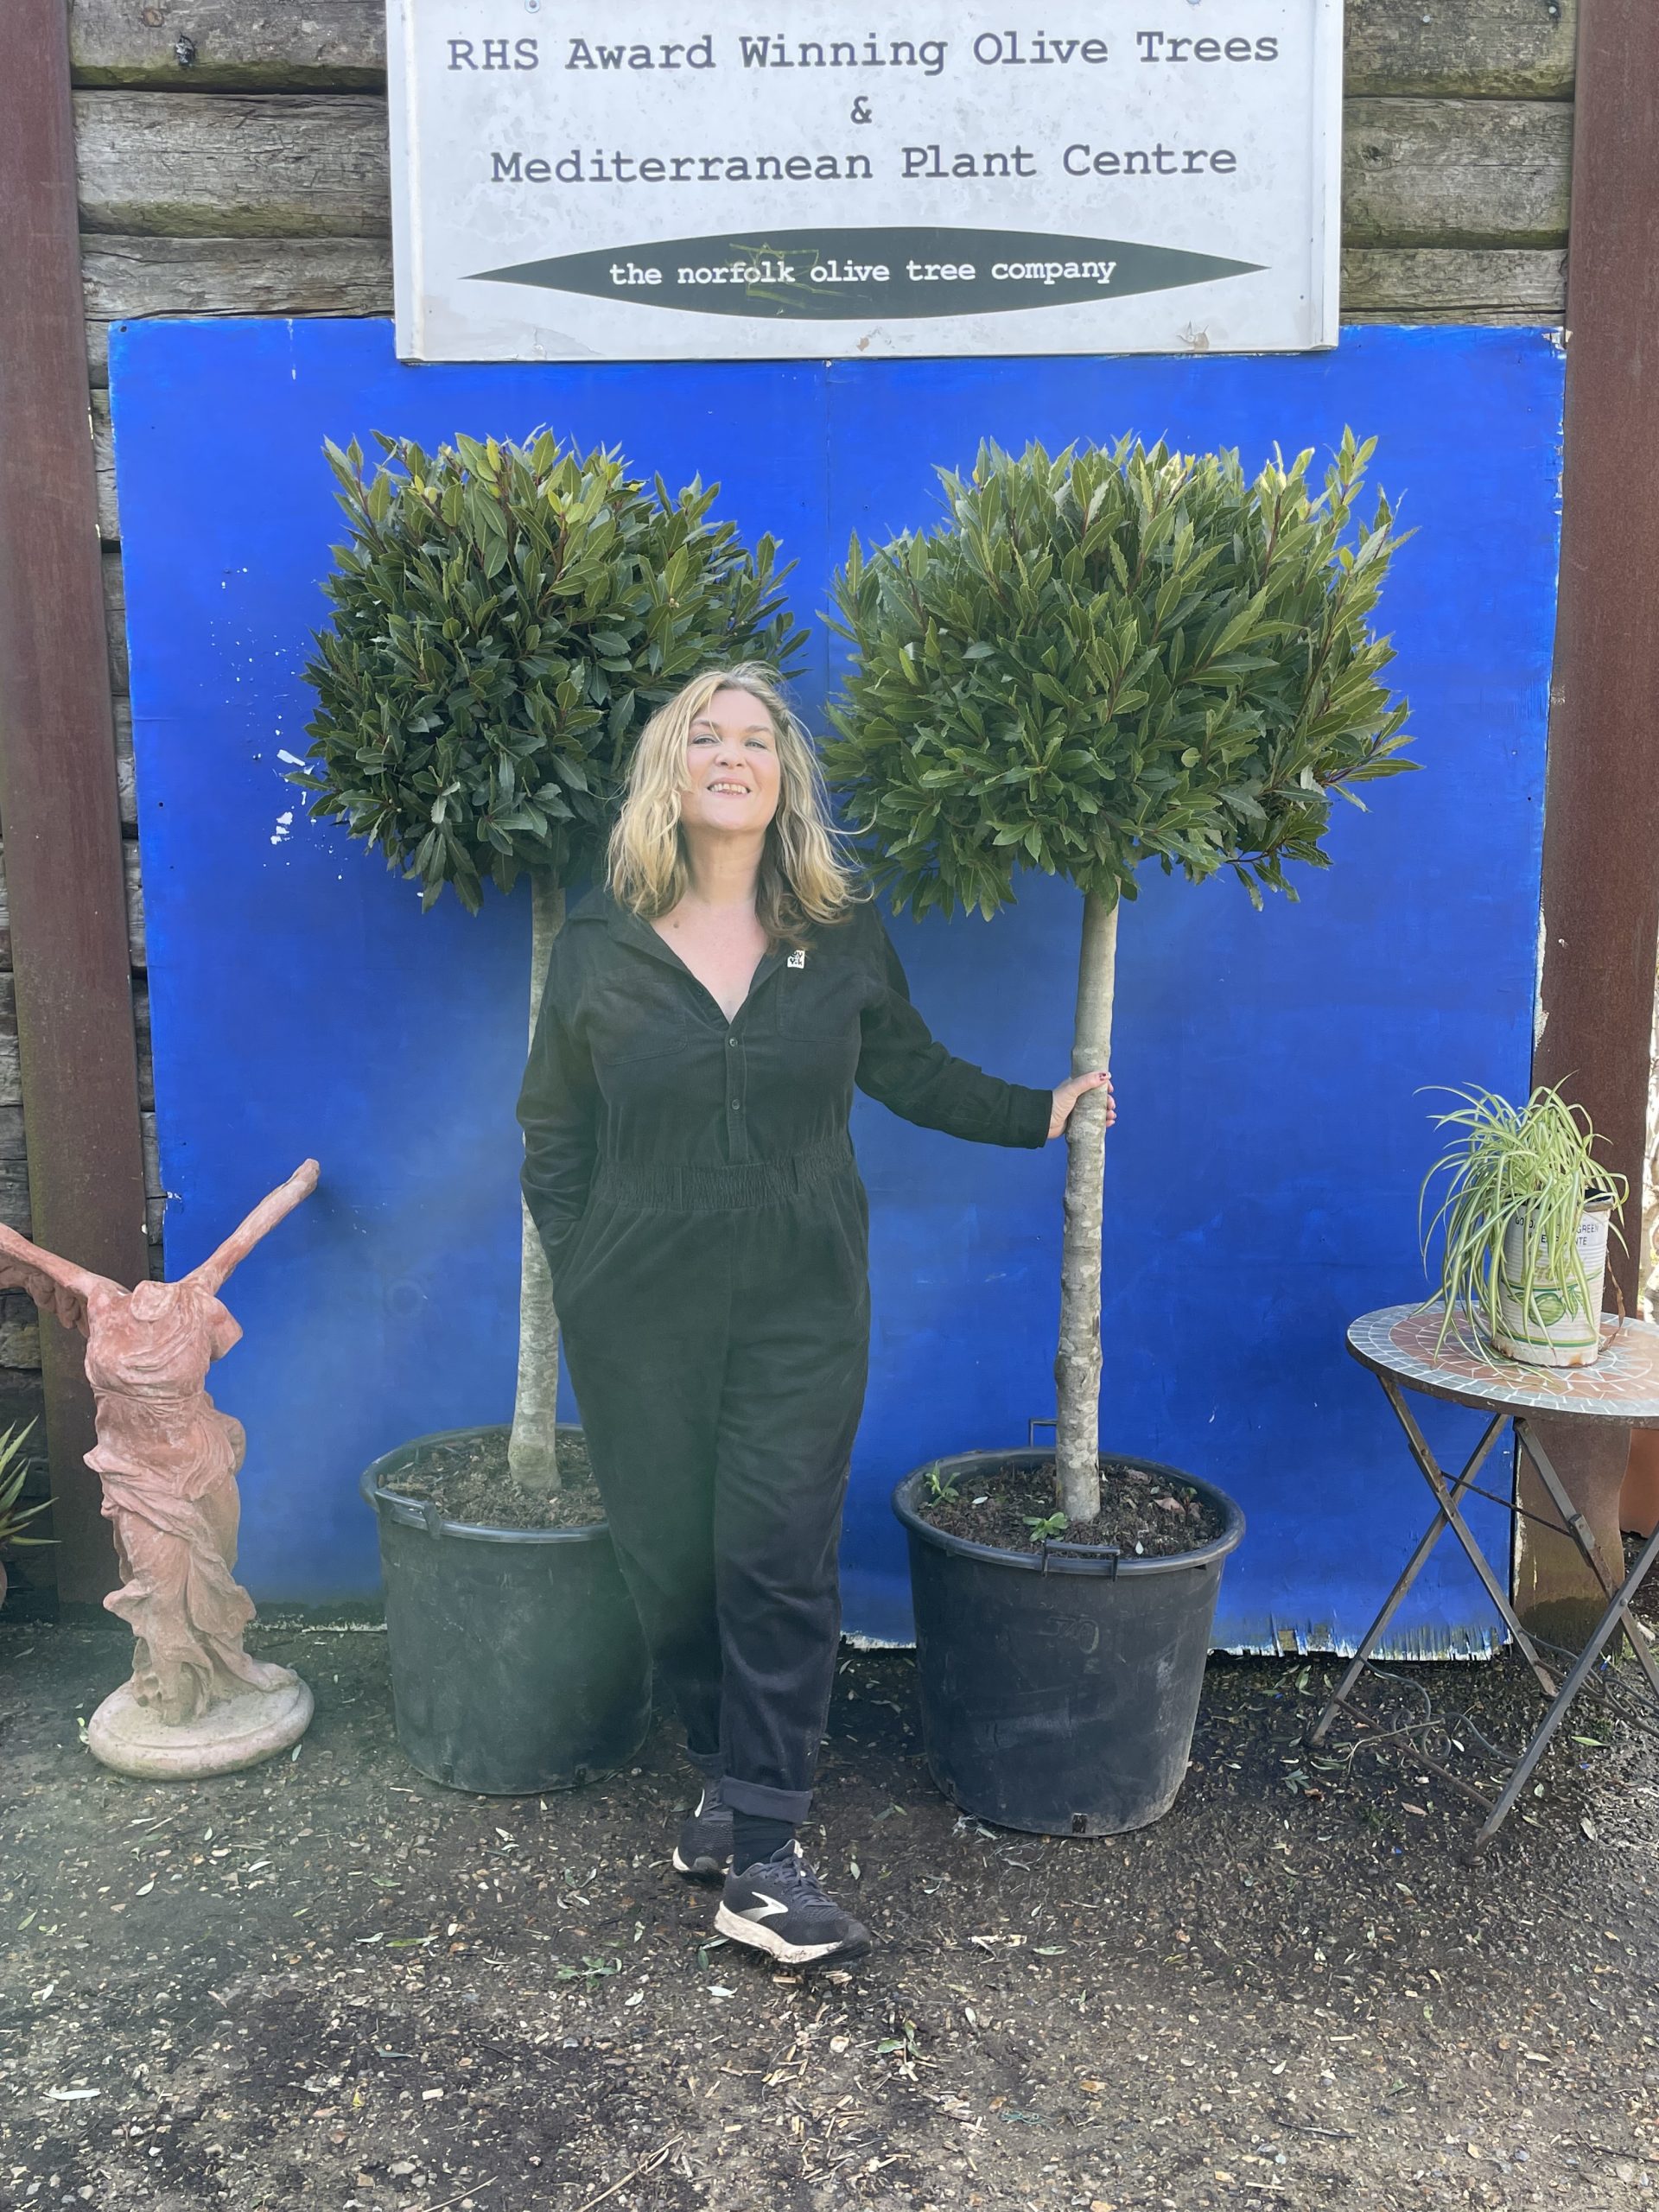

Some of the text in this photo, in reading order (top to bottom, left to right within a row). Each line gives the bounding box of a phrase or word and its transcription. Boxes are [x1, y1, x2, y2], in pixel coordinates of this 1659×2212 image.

[447, 30, 1279, 76] RHS Award Winning Olive Trees
[850, 95, 873, 124] &
[490, 143, 1237, 183] Mediterranean Plant Centre
[610, 259, 1117, 286] the norfolk olive tree company
